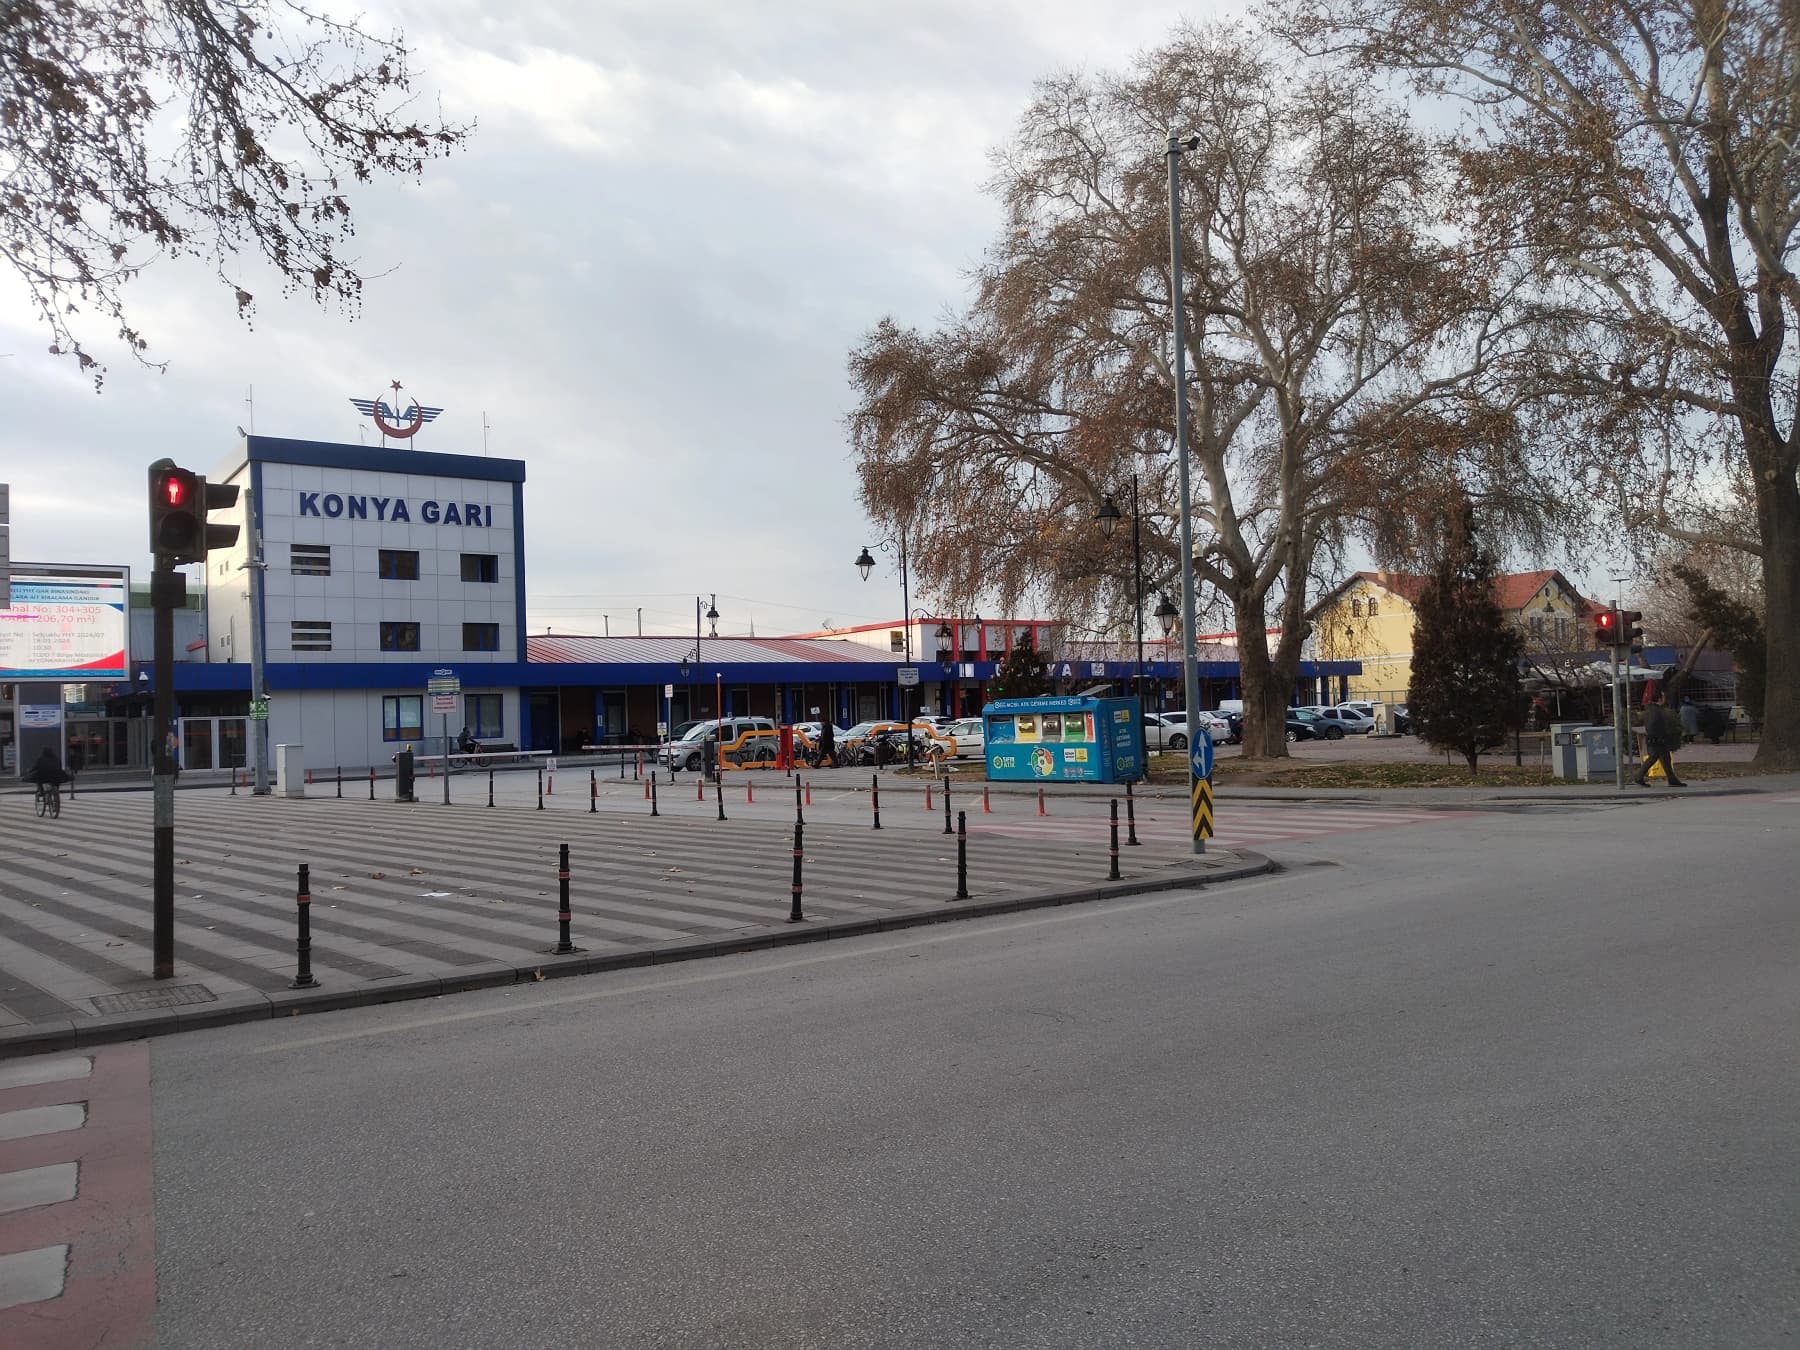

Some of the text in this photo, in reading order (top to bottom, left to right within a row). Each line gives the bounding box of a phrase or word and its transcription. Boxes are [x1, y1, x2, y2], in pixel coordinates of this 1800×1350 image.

[299, 491, 493, 528] KONYA GARI
[55, 606, 102, 615] 304+305
